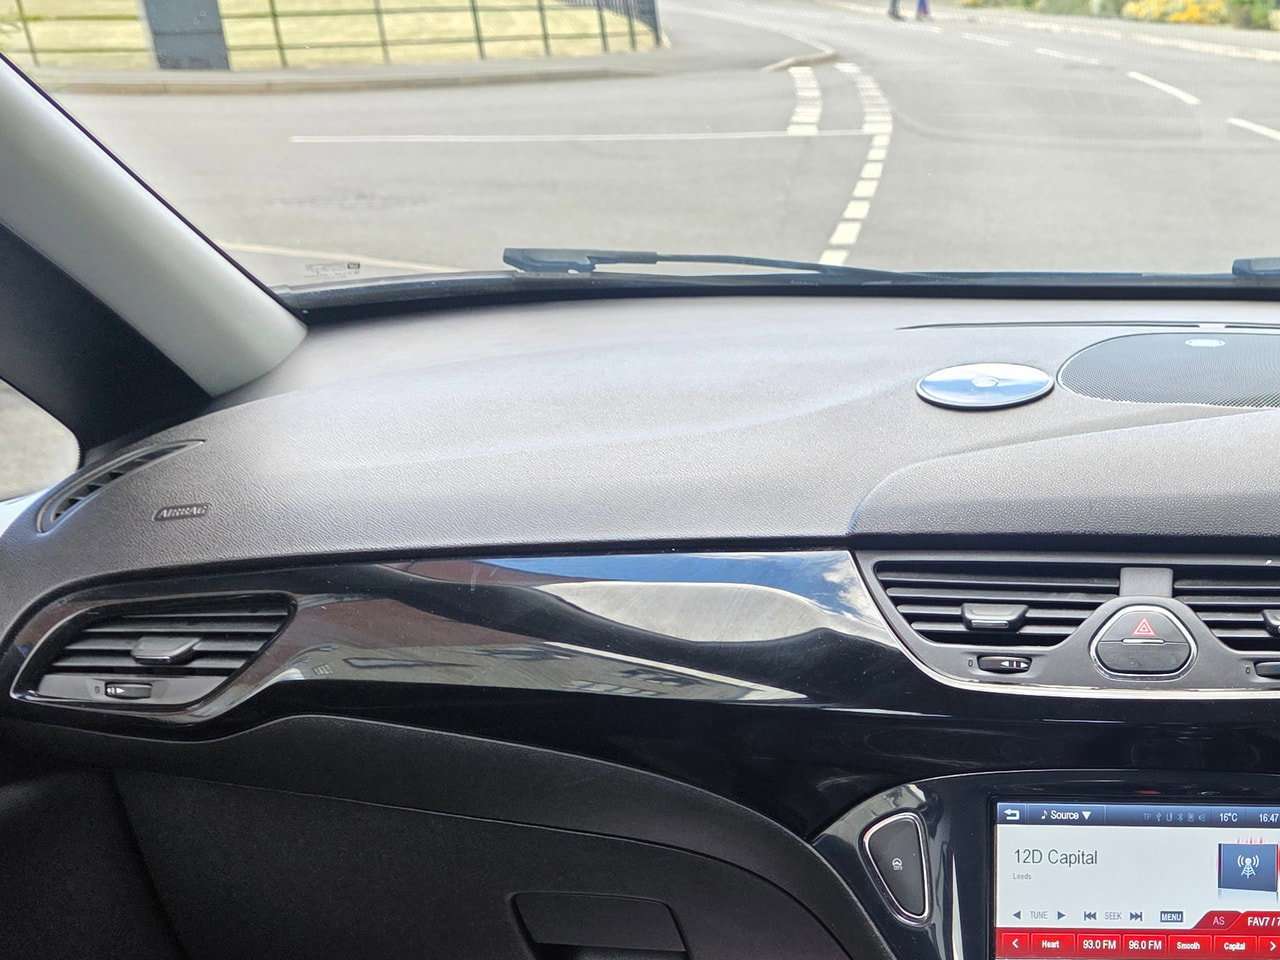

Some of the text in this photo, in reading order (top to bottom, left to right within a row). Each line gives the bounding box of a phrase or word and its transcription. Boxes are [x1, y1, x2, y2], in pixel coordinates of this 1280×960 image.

[1050, 810, 1080, 821] Source
[1219, 812, 1238, 823] 16°C
[1259, 812, 1280, 823] 16:47
[1013, 849, 1099, 868] 12D Capital
[1029, 911, 1182, 922] TUNE SEEK MENU
[1212, 916, 1225, 926] AS
[1041, 938, 1246, 952] Heart 93.0 FM 96.0 FM Smooth Capital
